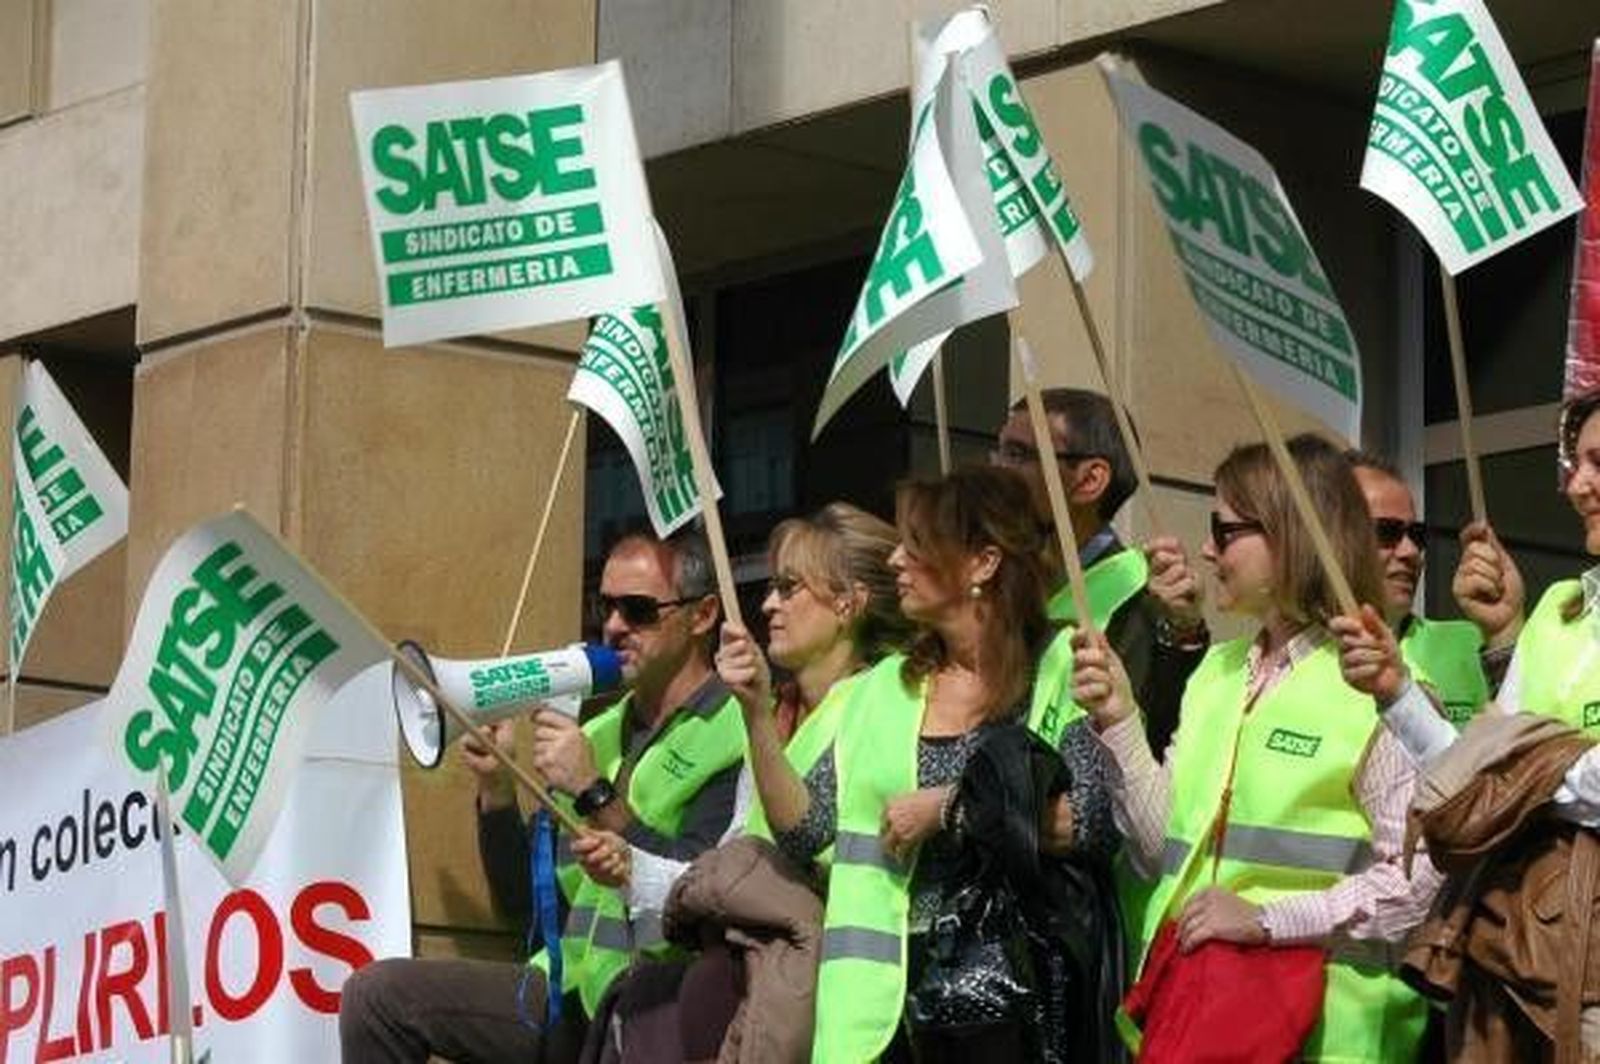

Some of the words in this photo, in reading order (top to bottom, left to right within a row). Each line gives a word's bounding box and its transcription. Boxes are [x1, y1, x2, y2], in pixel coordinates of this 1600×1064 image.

[371, 103, 596, 215] SATSE
[1380, 76, 1460, 157] DICATO
[1460, 167, 1493, 212] DE
[405, 219, 523, 255] SINDICATO
[534, 212, 577, 237] DE
[411, 255, 581, 300] ENFERMERIA
[124, 541, 286, 793] SATSE
[196, 669, 255, 804] SINDICATO
[252, 623, 289, 662] DE
[470, 658, 547, 687] SATSE
[224, 650, 315, 827] ENFERMERIA
[31, 788, 181, 881] colec
